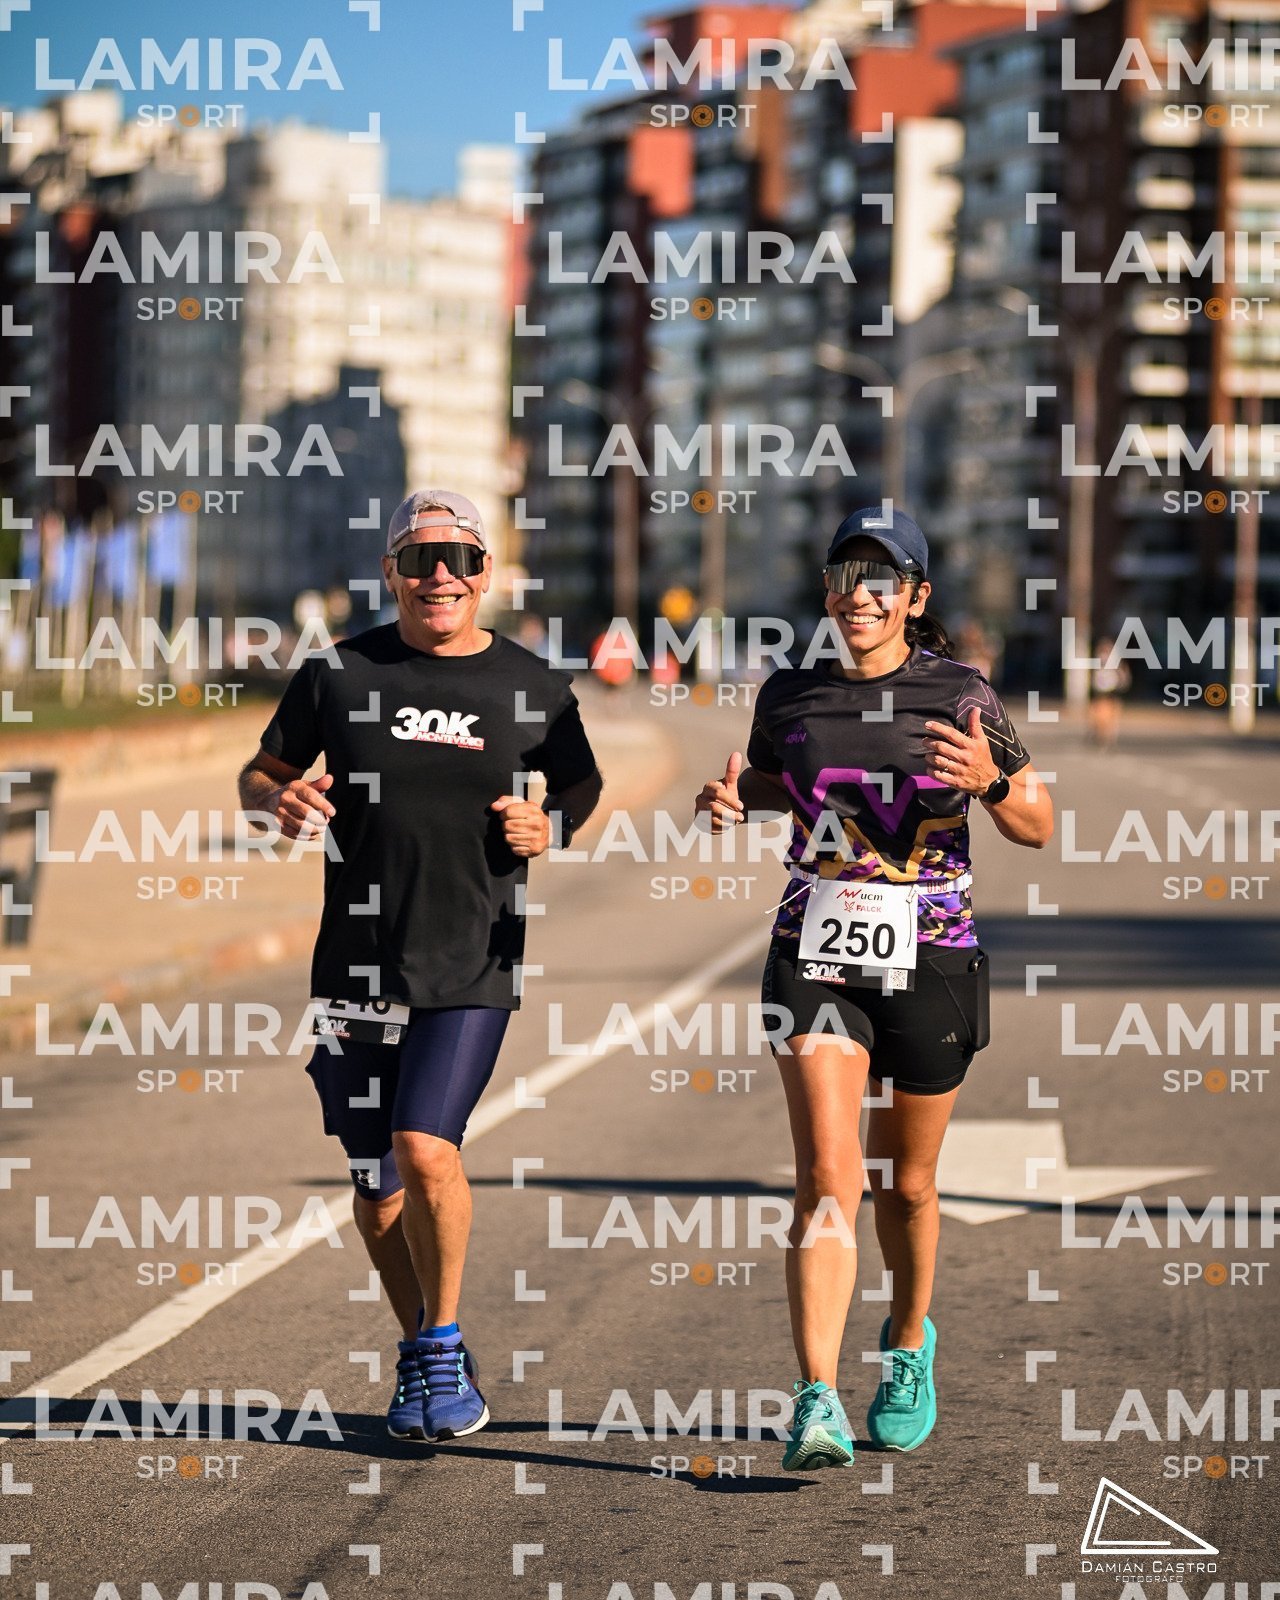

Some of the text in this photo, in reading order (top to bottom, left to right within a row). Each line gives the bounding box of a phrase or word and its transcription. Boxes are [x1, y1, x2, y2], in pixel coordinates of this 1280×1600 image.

[390, 706, 480, 740] 30K
[860, 892, 883, 902] ucm
[856, 904, 882, 914] FALCK
[818, 917, 896, 960] 250
[802, 962, 844, 980] 30K
[318, 1018, 348, 1035] 30K
